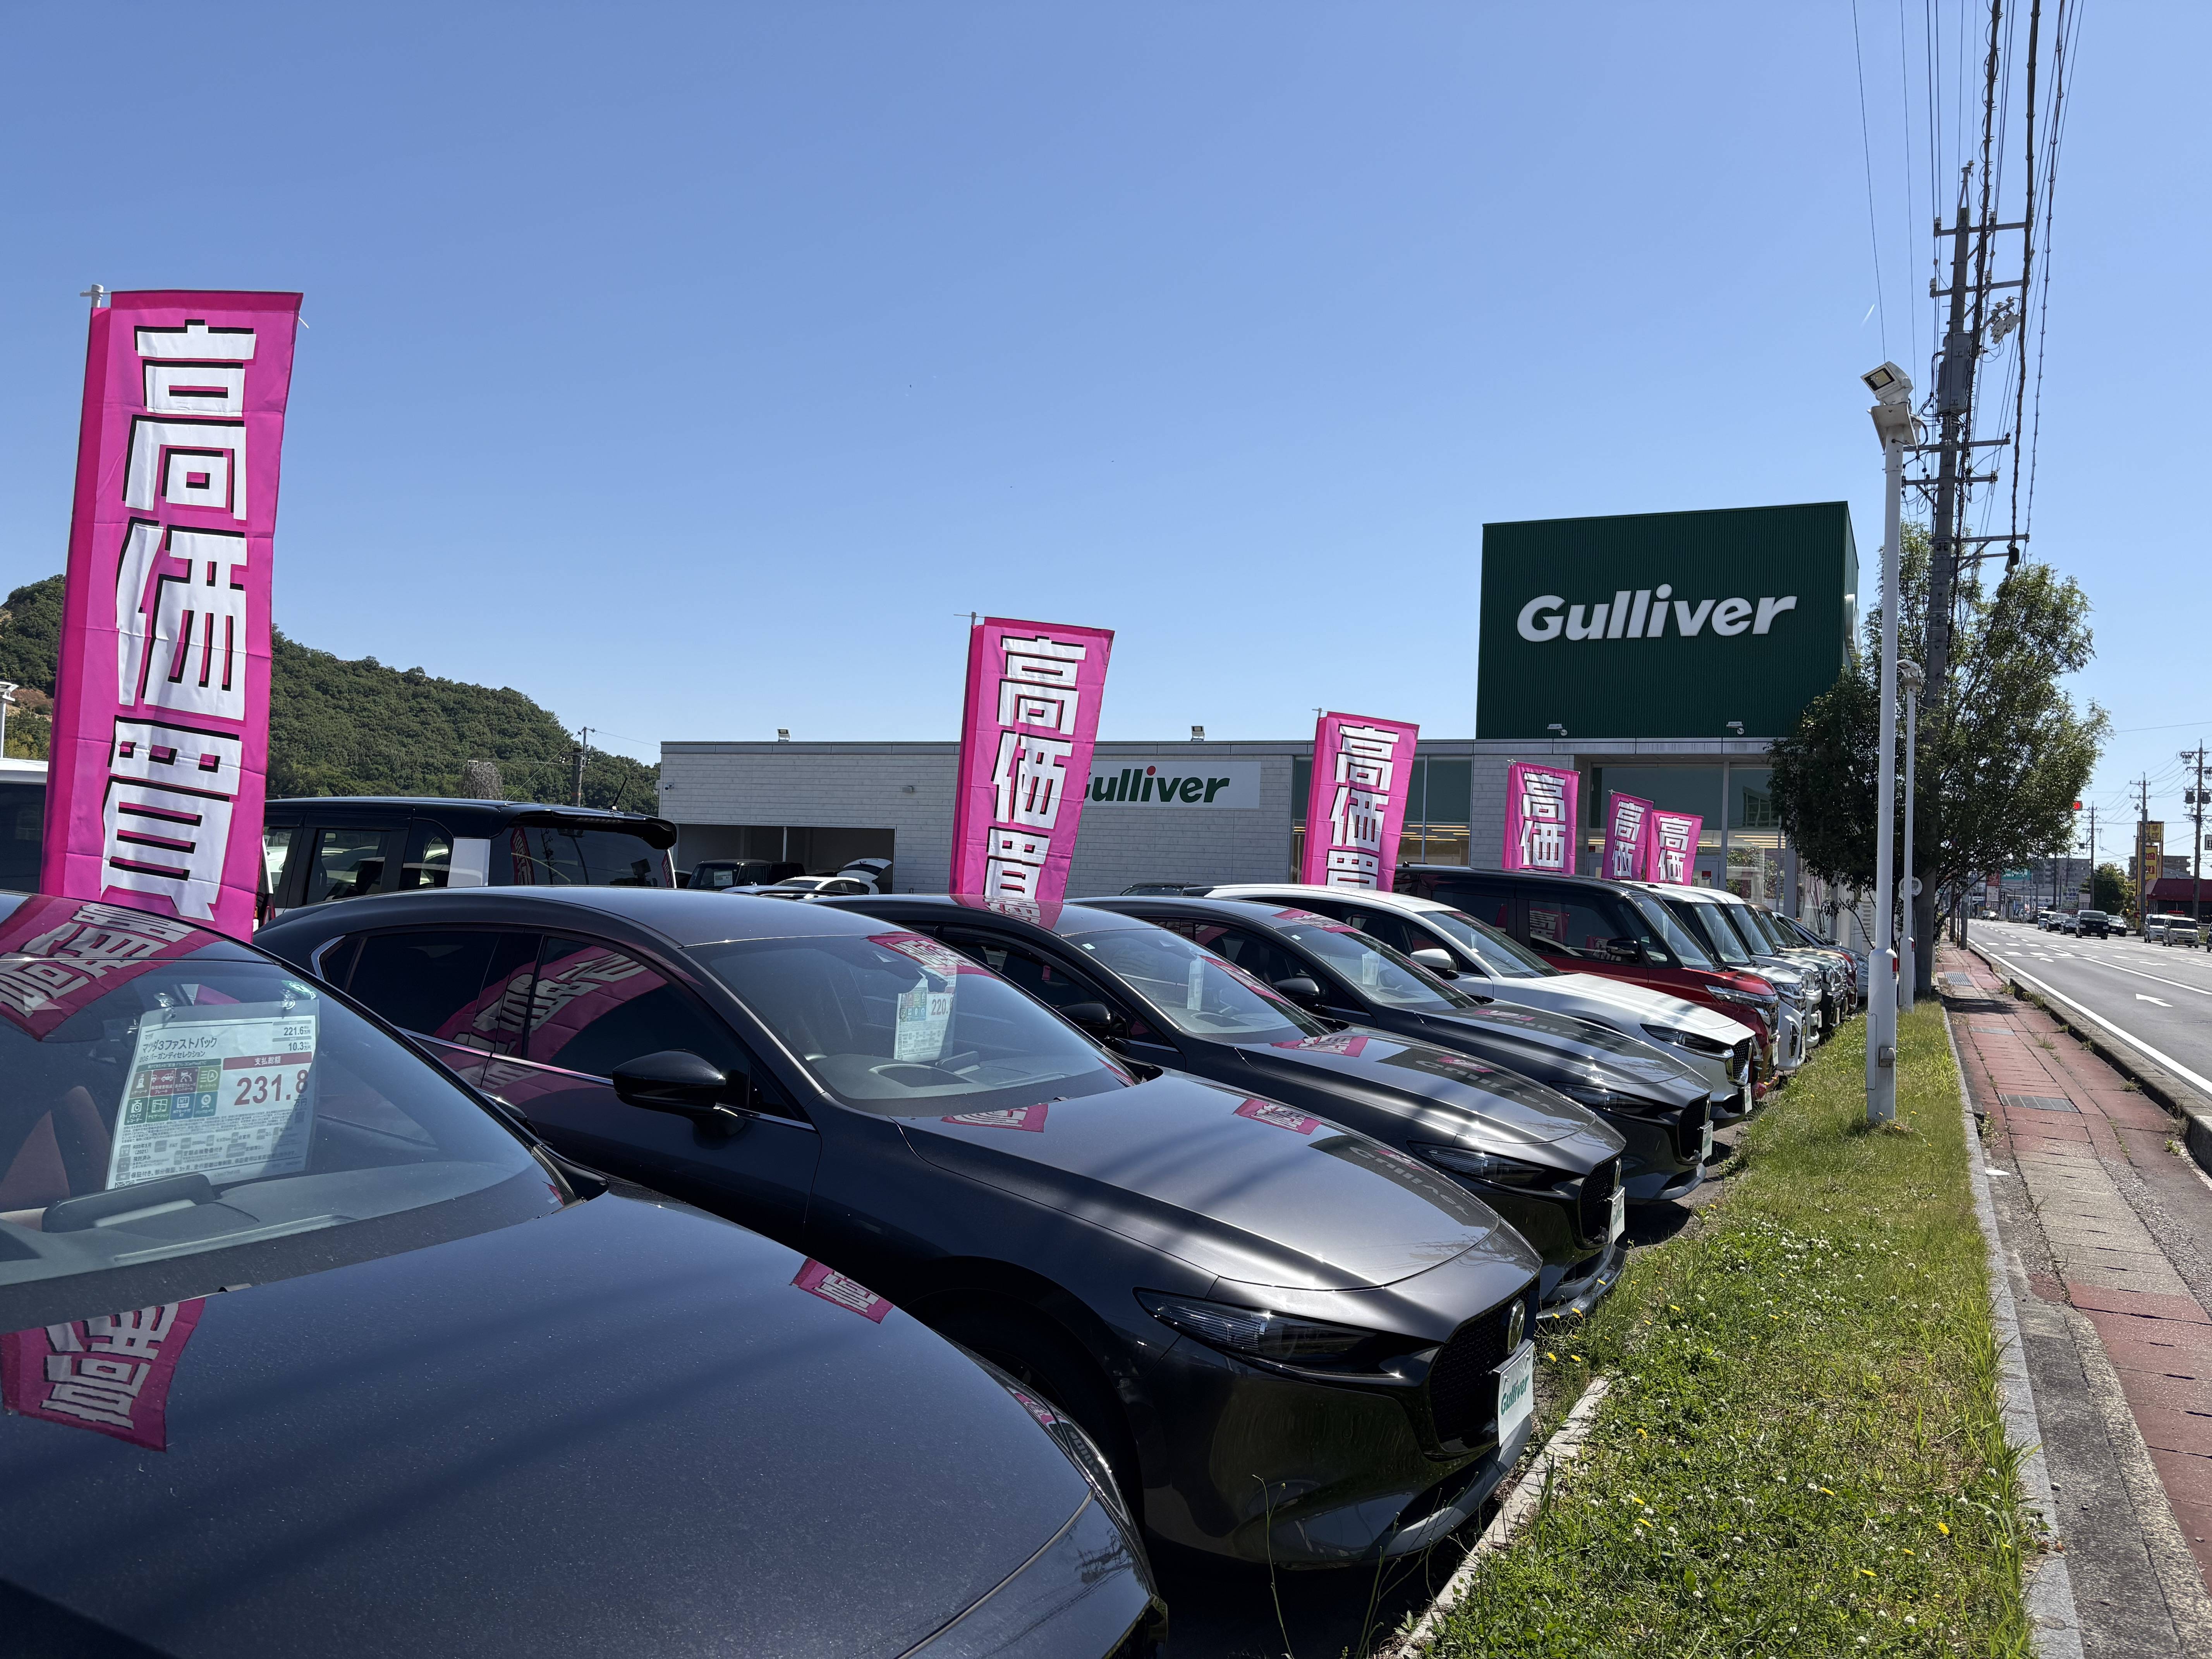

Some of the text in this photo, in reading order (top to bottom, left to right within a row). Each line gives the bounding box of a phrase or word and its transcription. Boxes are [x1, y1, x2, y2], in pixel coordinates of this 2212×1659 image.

[1517, 584, 1797, 642] Gulliver
[1085, 766, 1230, 804] ulliver
[1520, 771, 1566, 868] 高価
[284, 1026, 304, 1036] 221.6
[289, 1042, 304, 1051] 10.3
[254, 1056, 282, 1066] 支払総額
[234, 1070, 308, 1106] 231.8
[294, 1098, 307, 1107] 万円
[1501, 1374, 1529, 1416] Gulliver
